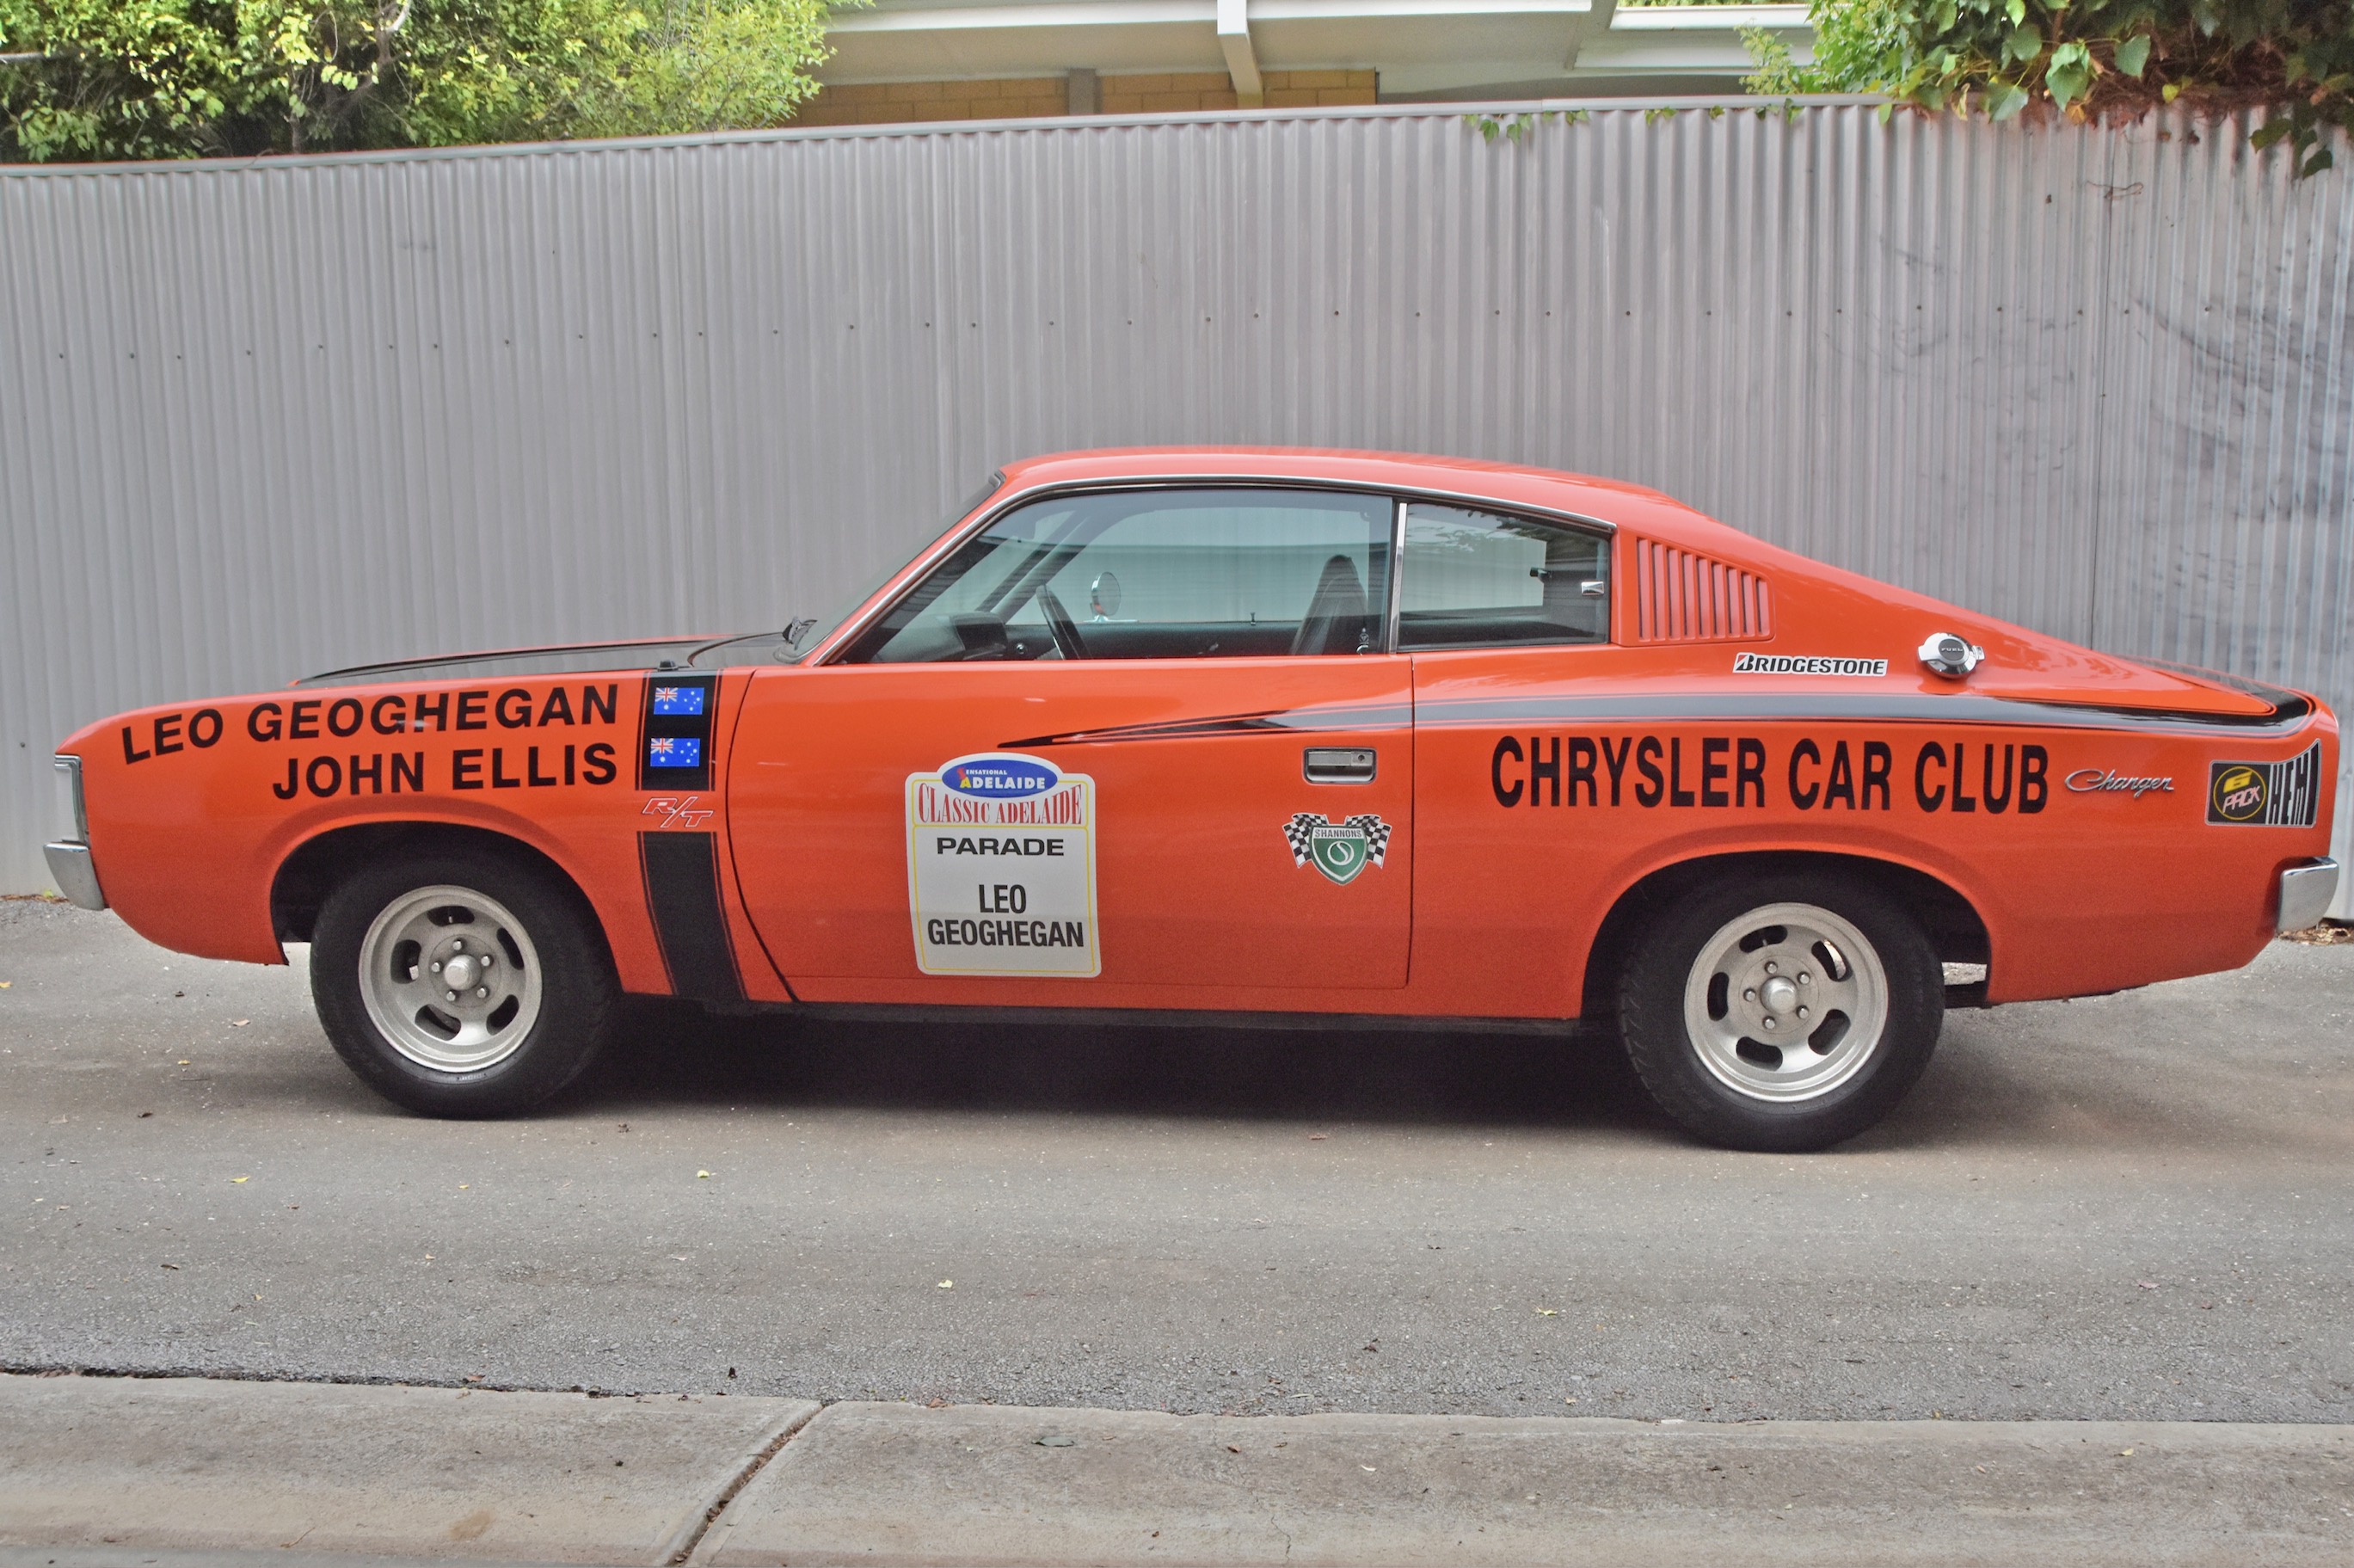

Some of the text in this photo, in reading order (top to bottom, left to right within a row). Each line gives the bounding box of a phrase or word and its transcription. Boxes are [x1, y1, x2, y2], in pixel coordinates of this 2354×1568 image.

[1736, 654, 1885, 675] BRIDGESTONE
[121, 684, 618, 765] LEO GEOGHEGAN
[272, 742, 618, 800] JOHN ELLIS
[959, 777, 1046, 790] ADELAIDE
[1491, 735, 2050, 815] CHRYSLER CAR CLUB
[2064, 769, 2175, 798] Charger
[2222, 771, 2253, 793] 6
[642, 796, 714, 828] R/T
[918, 783, 1082, 825] CLASSIC ADELAIDE
[2222, 785, 2261, 814] PACK
[937, 837, 1064, 857] PARADE
[1314, 828, 1362, 838] SHANNONS
[978, 884, 1027, 914] LEO
[927, 919, 1085, 947] GEOGHEGAN
